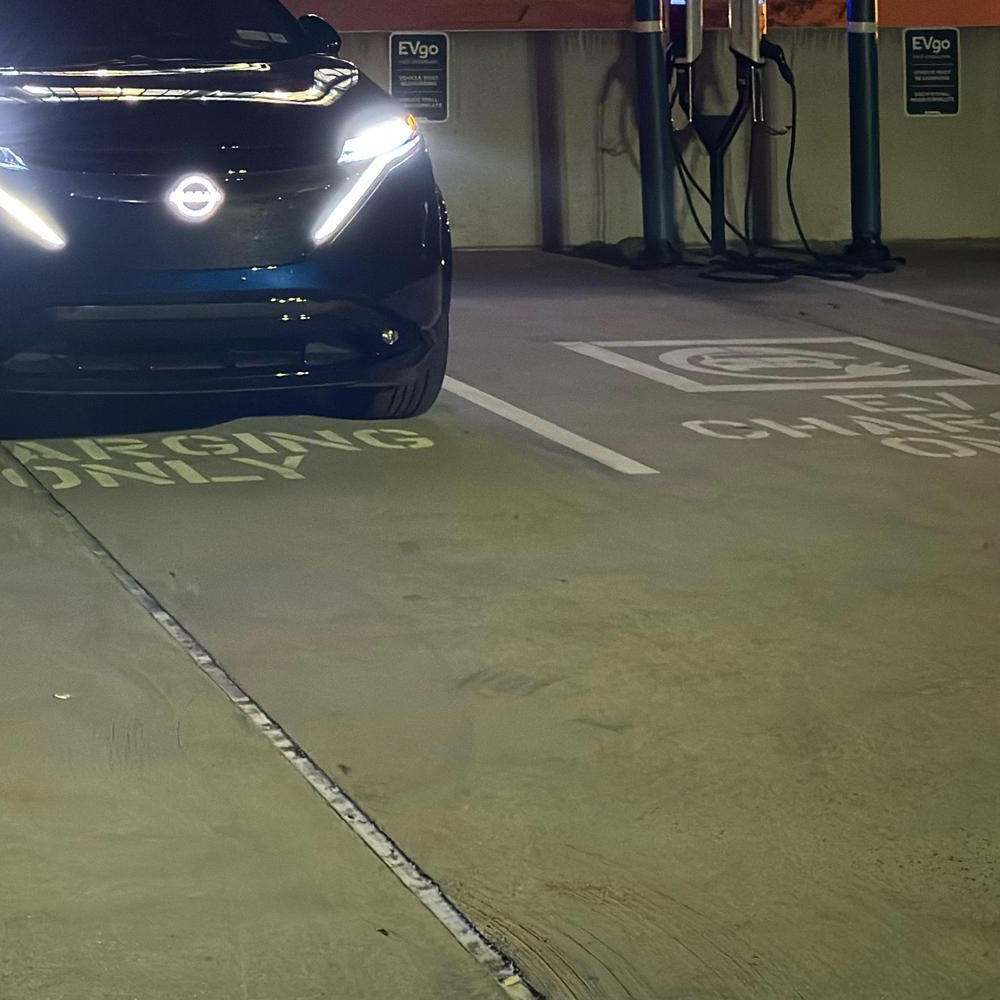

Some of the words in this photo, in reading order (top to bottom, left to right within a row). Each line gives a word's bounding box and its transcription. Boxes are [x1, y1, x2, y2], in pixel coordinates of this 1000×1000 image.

[398, 41, 440, 59] EVgo
[911, 36, 951, 53] EVgo
[824, 391, 976, 411] EV
[682, 411, 1000, 439] CHAR
[1, 452, 306, 491] ONLY
